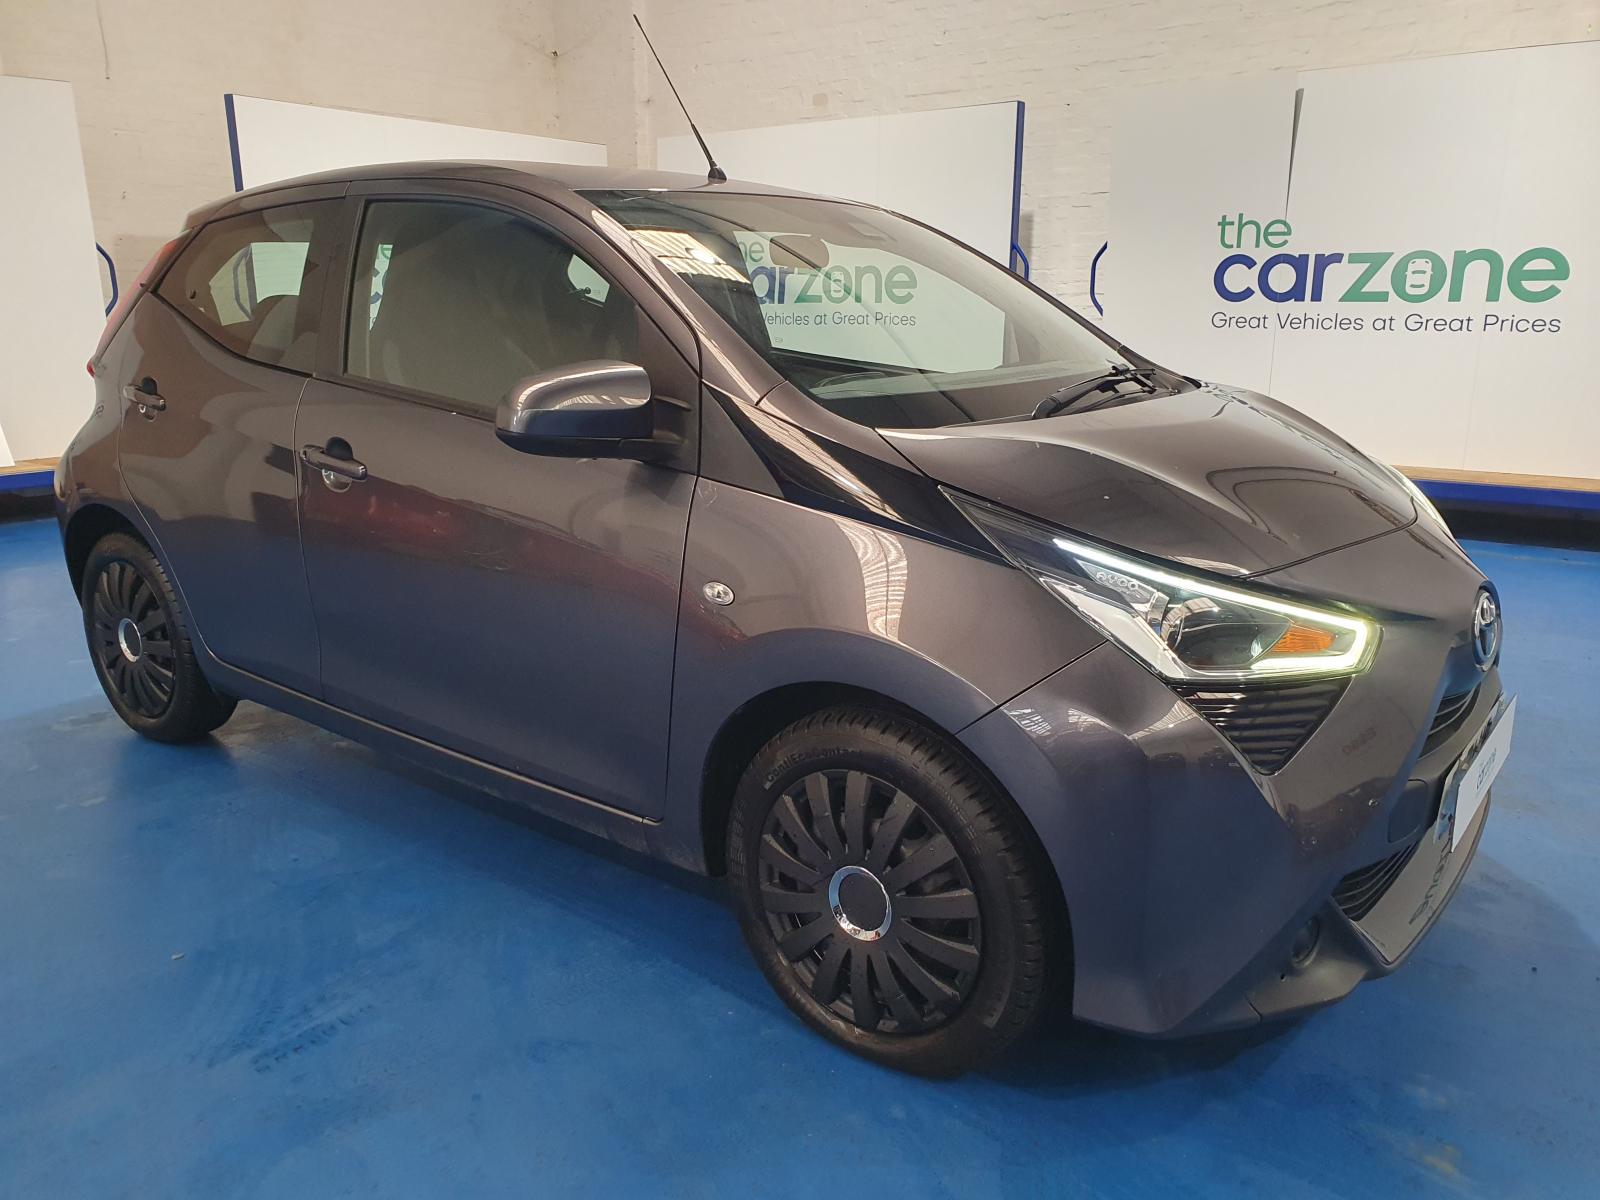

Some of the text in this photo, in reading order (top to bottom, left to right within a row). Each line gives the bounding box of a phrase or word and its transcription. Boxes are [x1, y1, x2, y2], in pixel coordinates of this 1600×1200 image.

[1217, 213, 1293, 249] the
[751, 265, 918, 304] arzone
[1213, 247, 1571, 304] carzone
[814, 313, 828, 326] at
[832, 311, 870, 326] Great
[874, 312, 917, 326] Prices
[1211, 311, 1562, 333] Great Vehicles at Great Prices
